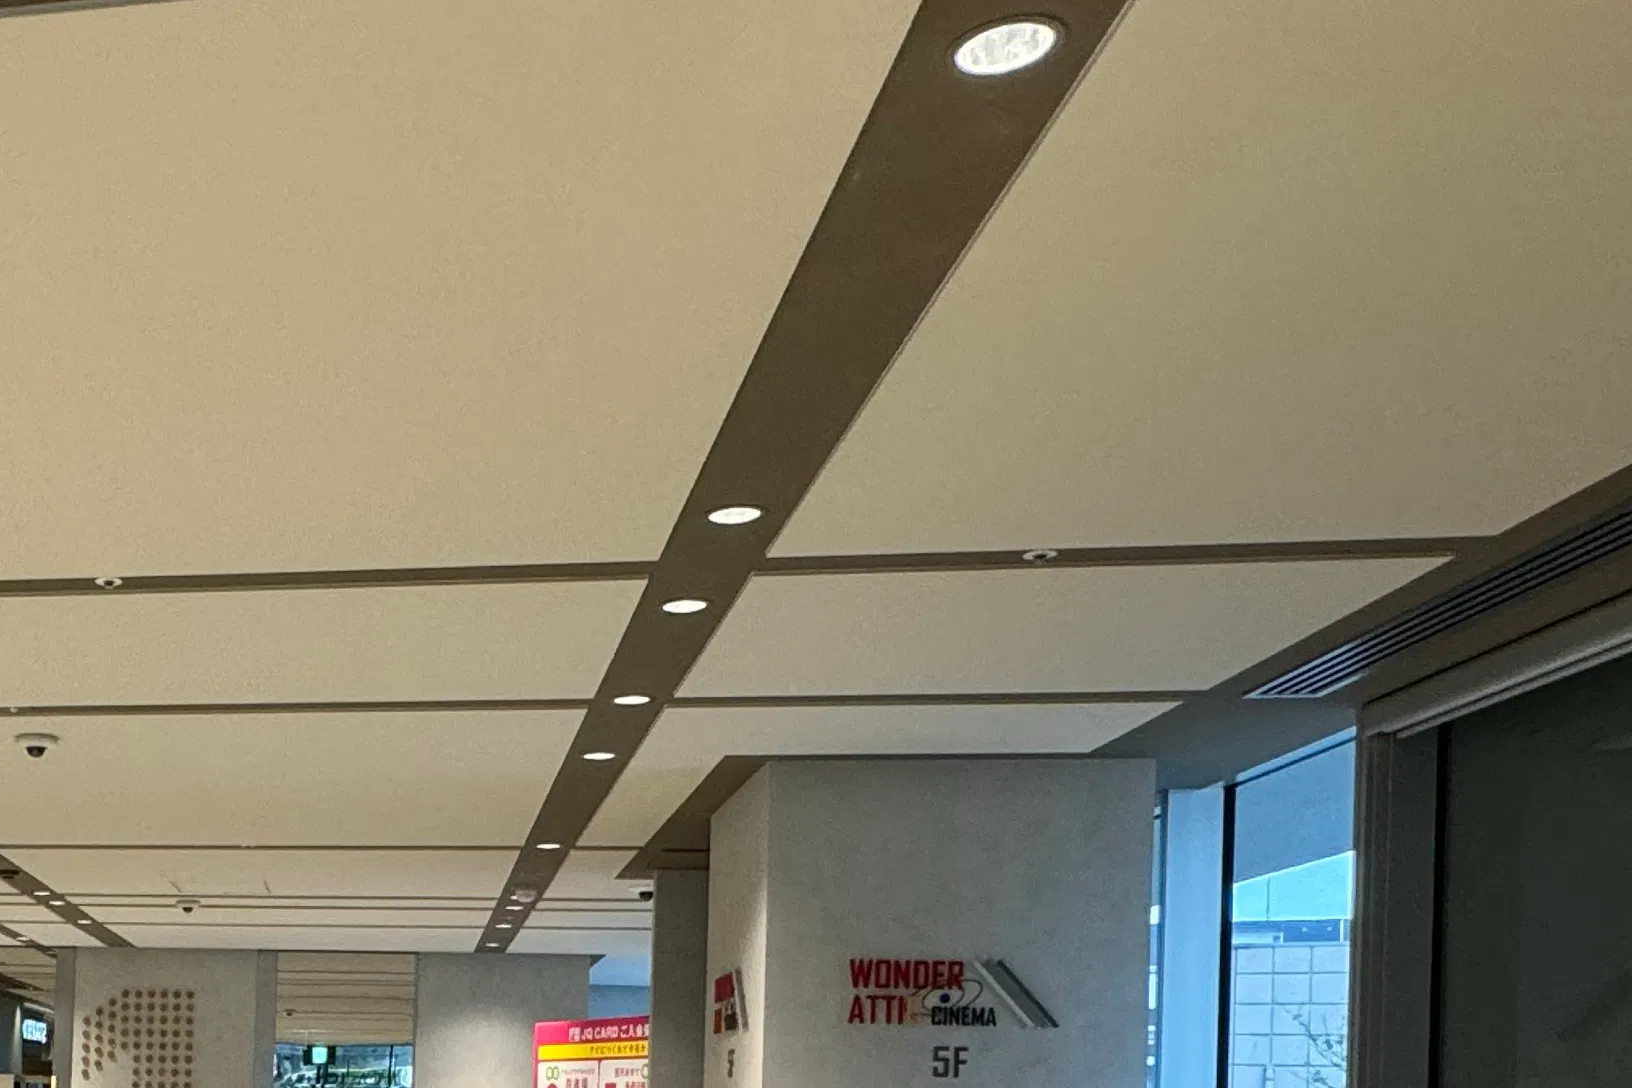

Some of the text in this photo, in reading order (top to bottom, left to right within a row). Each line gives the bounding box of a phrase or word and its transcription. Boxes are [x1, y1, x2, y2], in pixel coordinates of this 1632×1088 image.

[849, 958, 965, 990] WONDER
[931, 1005, 997, 1027] CINEMA
[932, 1046, 970, 1078] 5F
